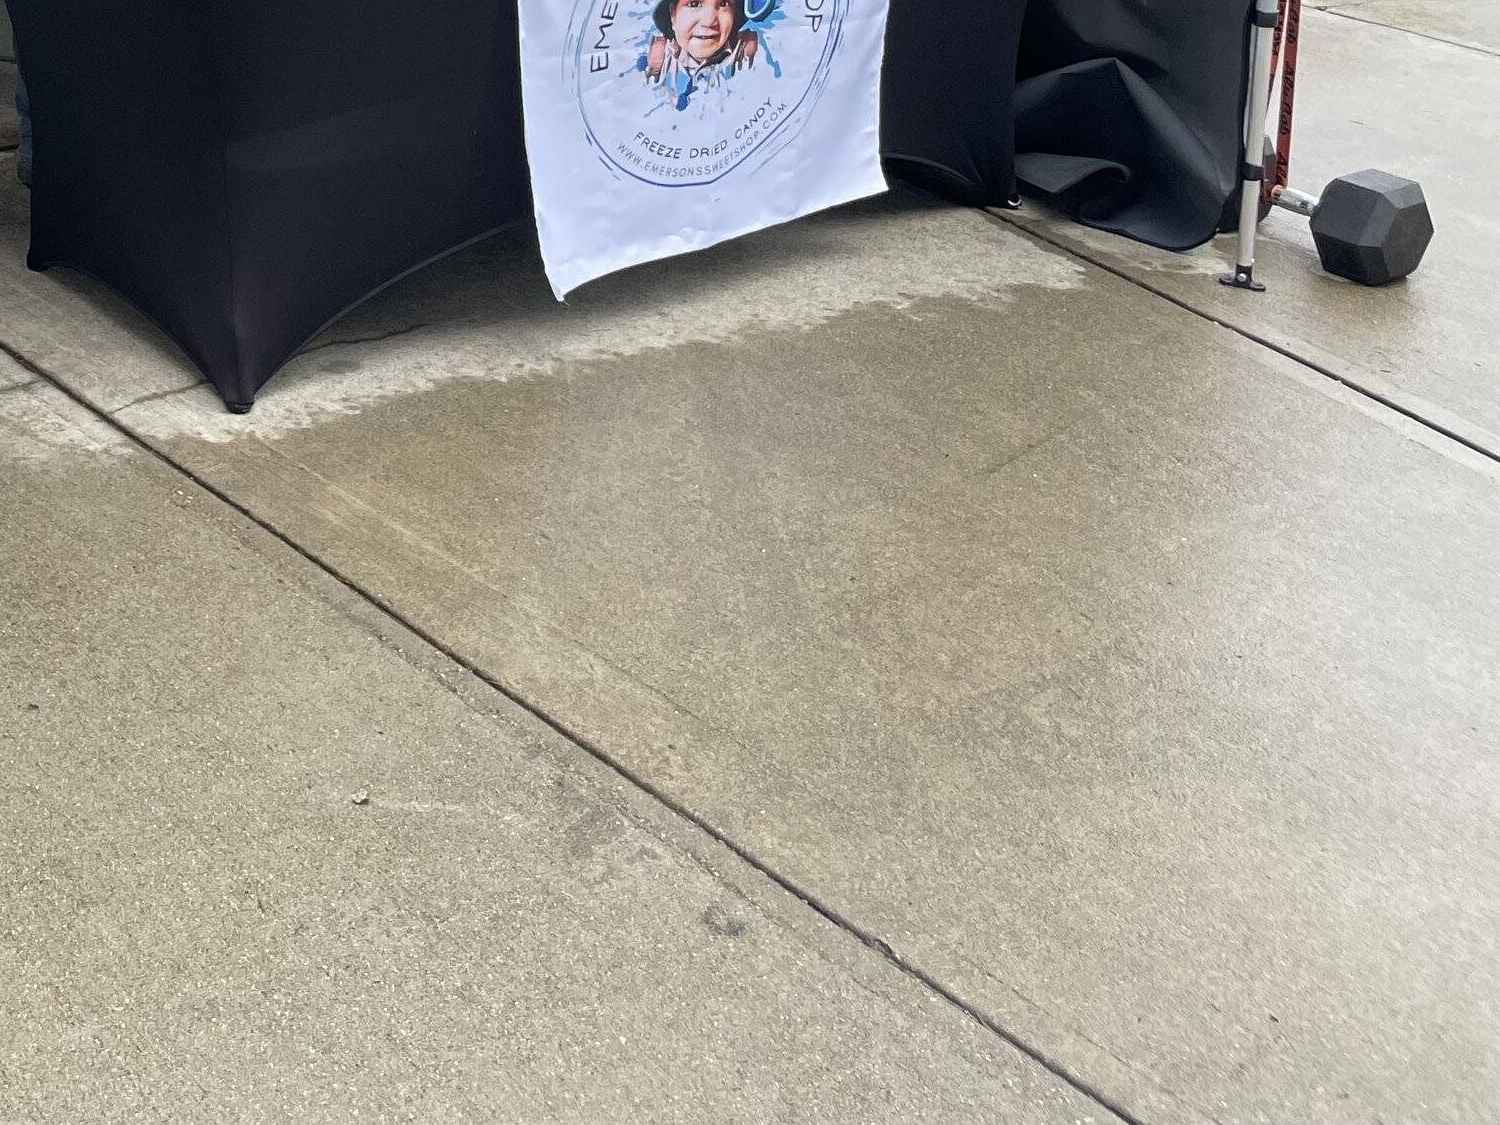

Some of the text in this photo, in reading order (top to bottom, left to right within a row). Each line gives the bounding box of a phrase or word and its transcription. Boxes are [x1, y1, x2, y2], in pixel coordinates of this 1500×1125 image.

[634, 97, 772, 159] FREEZE DRIED CANDY
